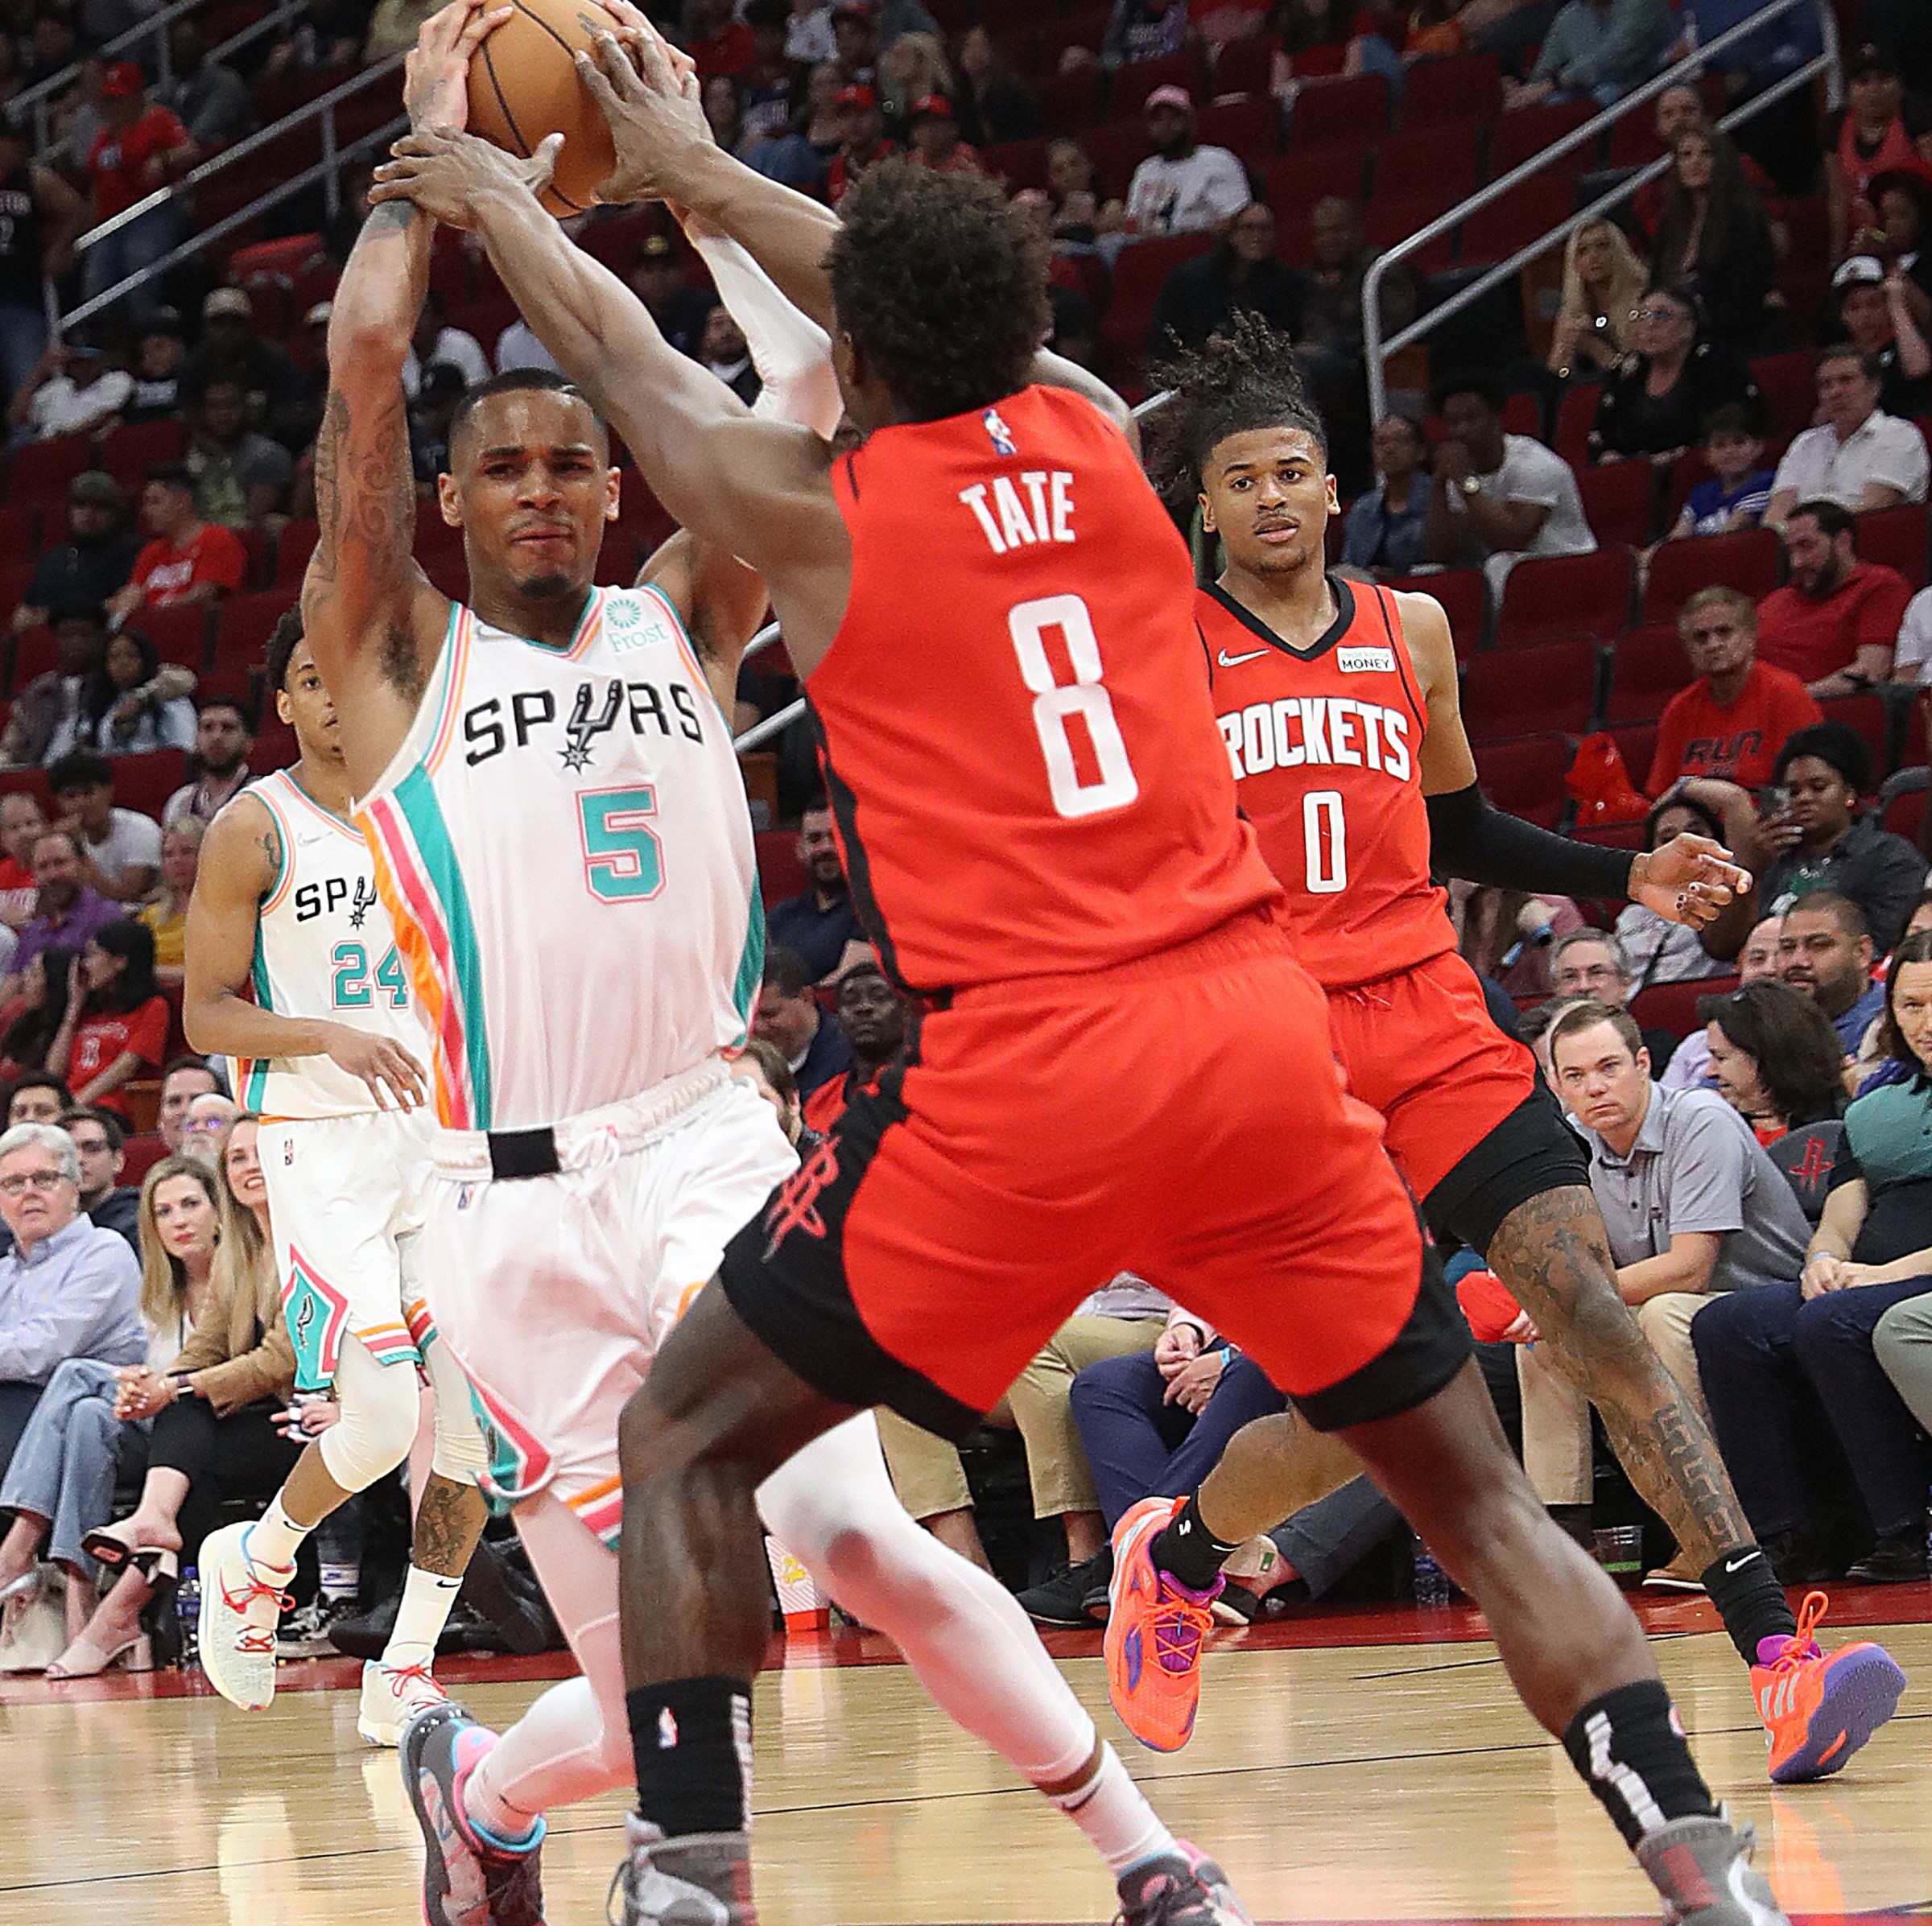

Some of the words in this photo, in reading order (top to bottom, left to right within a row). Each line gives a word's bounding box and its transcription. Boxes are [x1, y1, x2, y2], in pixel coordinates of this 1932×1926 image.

[959, 470, 1075, 554] TATE
[608, 621, 668, 653] Frost
[1342, 658, 1389, 670] MONEY
[464, 678, 704, 774] SPURS
[1008, 593, 1139, 819] 8
[1215, 697, 1410, 782] ROCKETS
[575, 783, 667, 905] 5
[1302, 790, 1348, 894] 0
[295, 875, 378, 931] SPU
[330, 939, 410, 1010] 24
